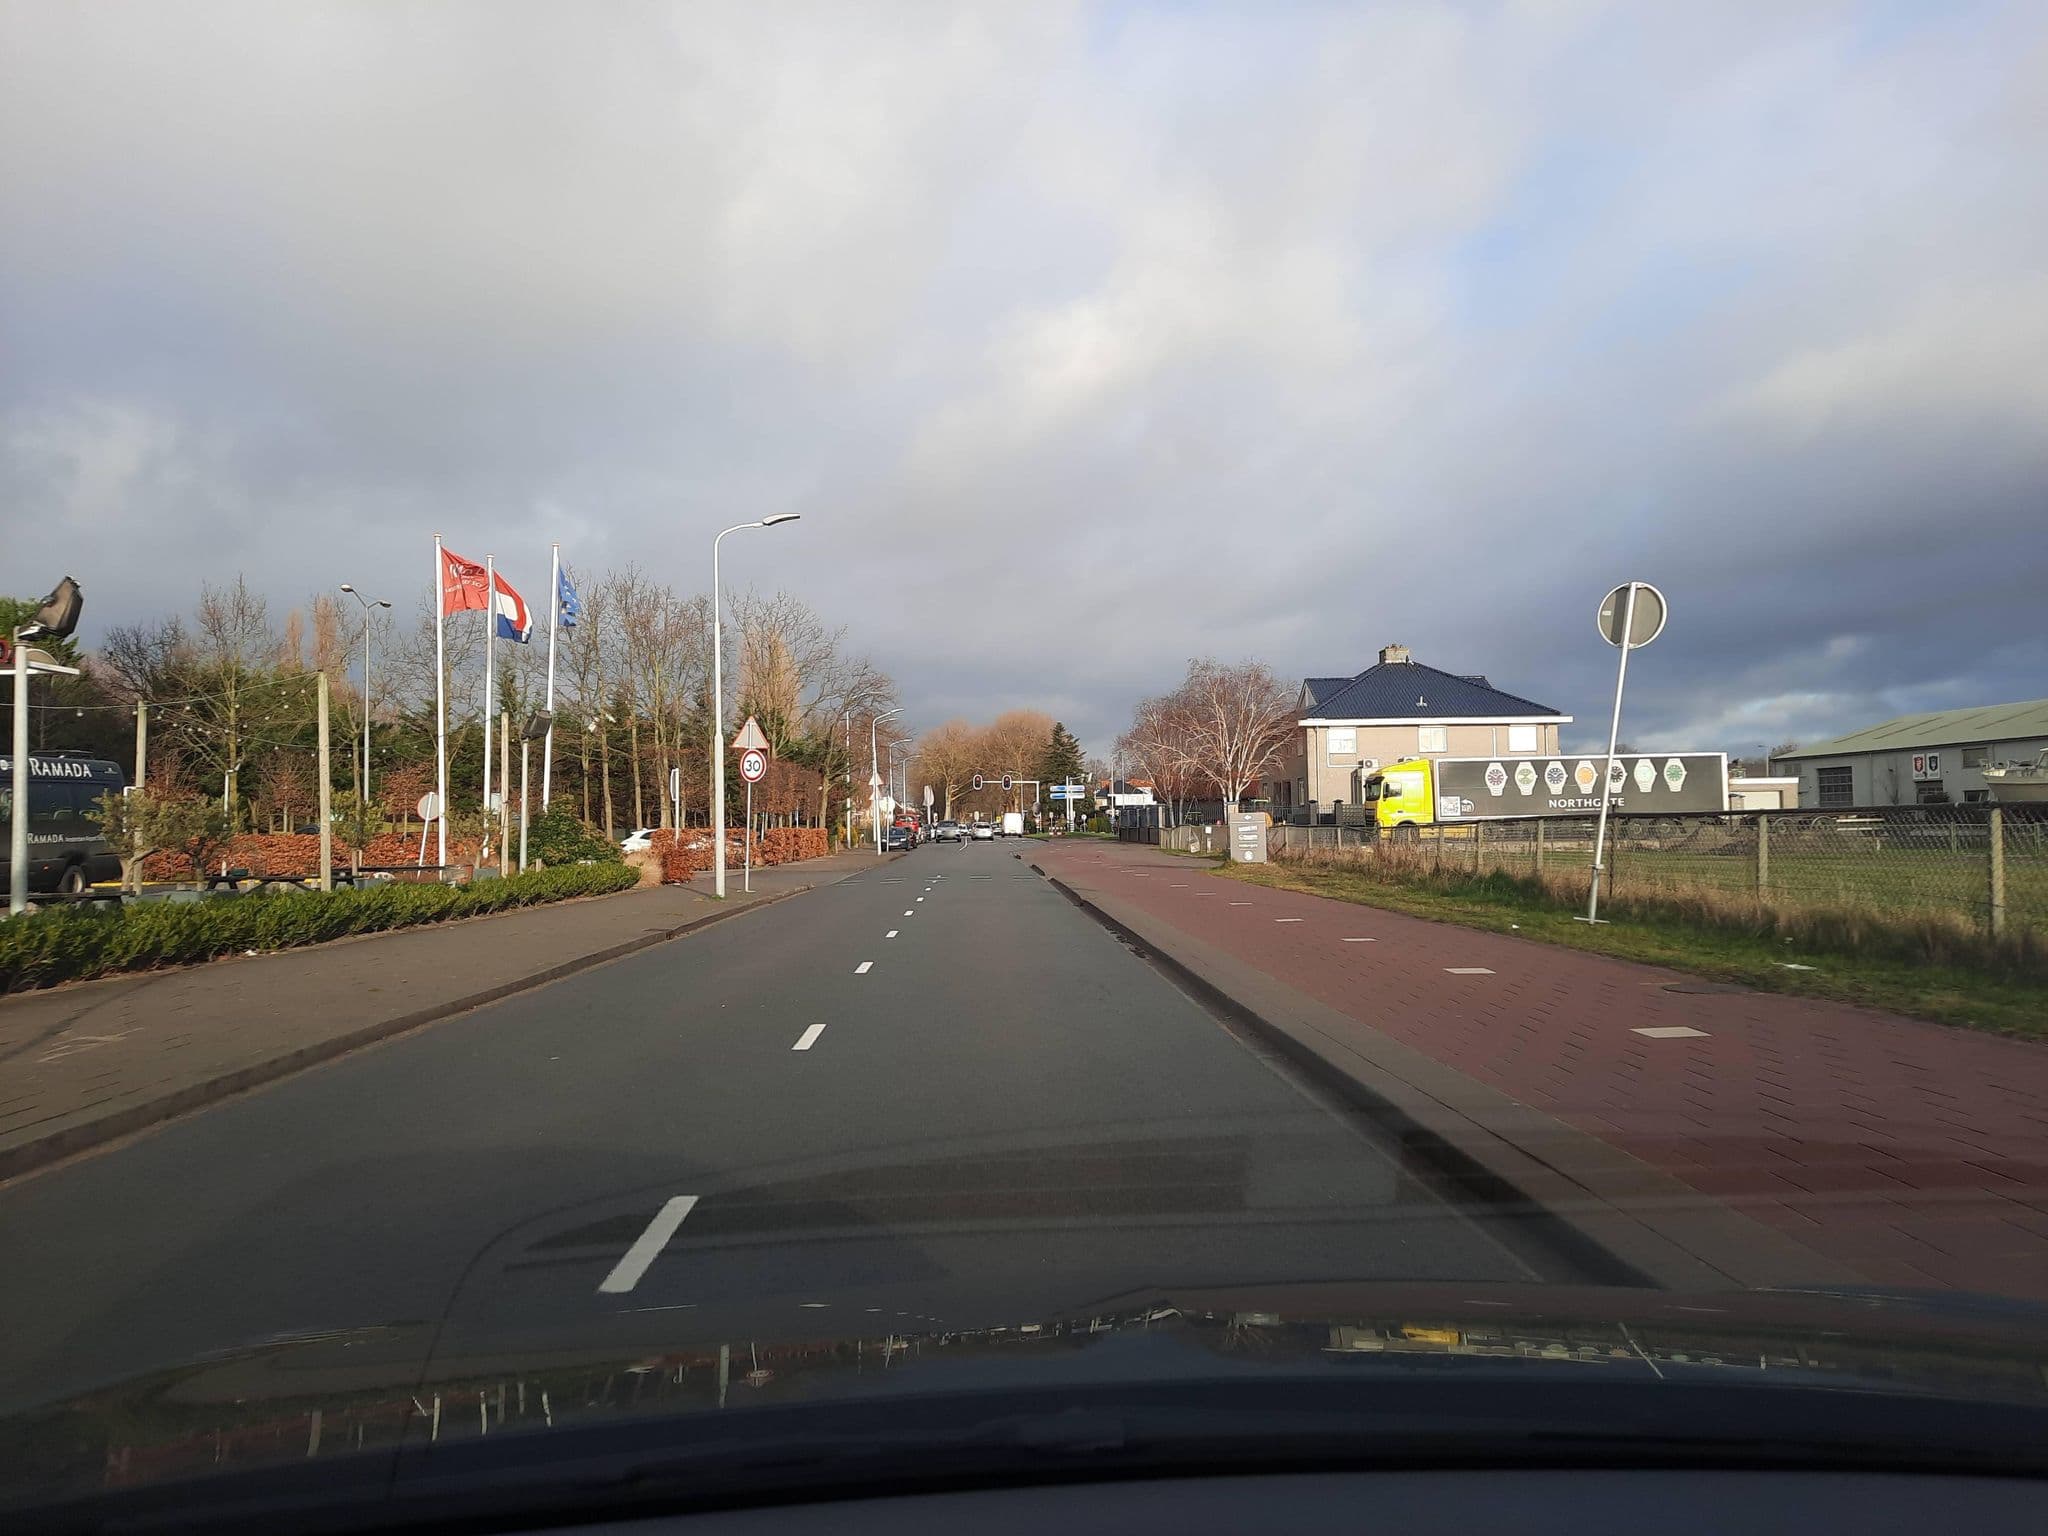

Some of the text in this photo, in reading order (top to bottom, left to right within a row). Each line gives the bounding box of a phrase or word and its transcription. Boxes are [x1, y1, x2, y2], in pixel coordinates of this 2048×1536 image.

[28, 758, 93, 778] RAMADA
[745, 760, 761, 772] 30
[1548, 797, 1625, 808] NORTHGTE
[26, 833, 64, 844] RAMADA
